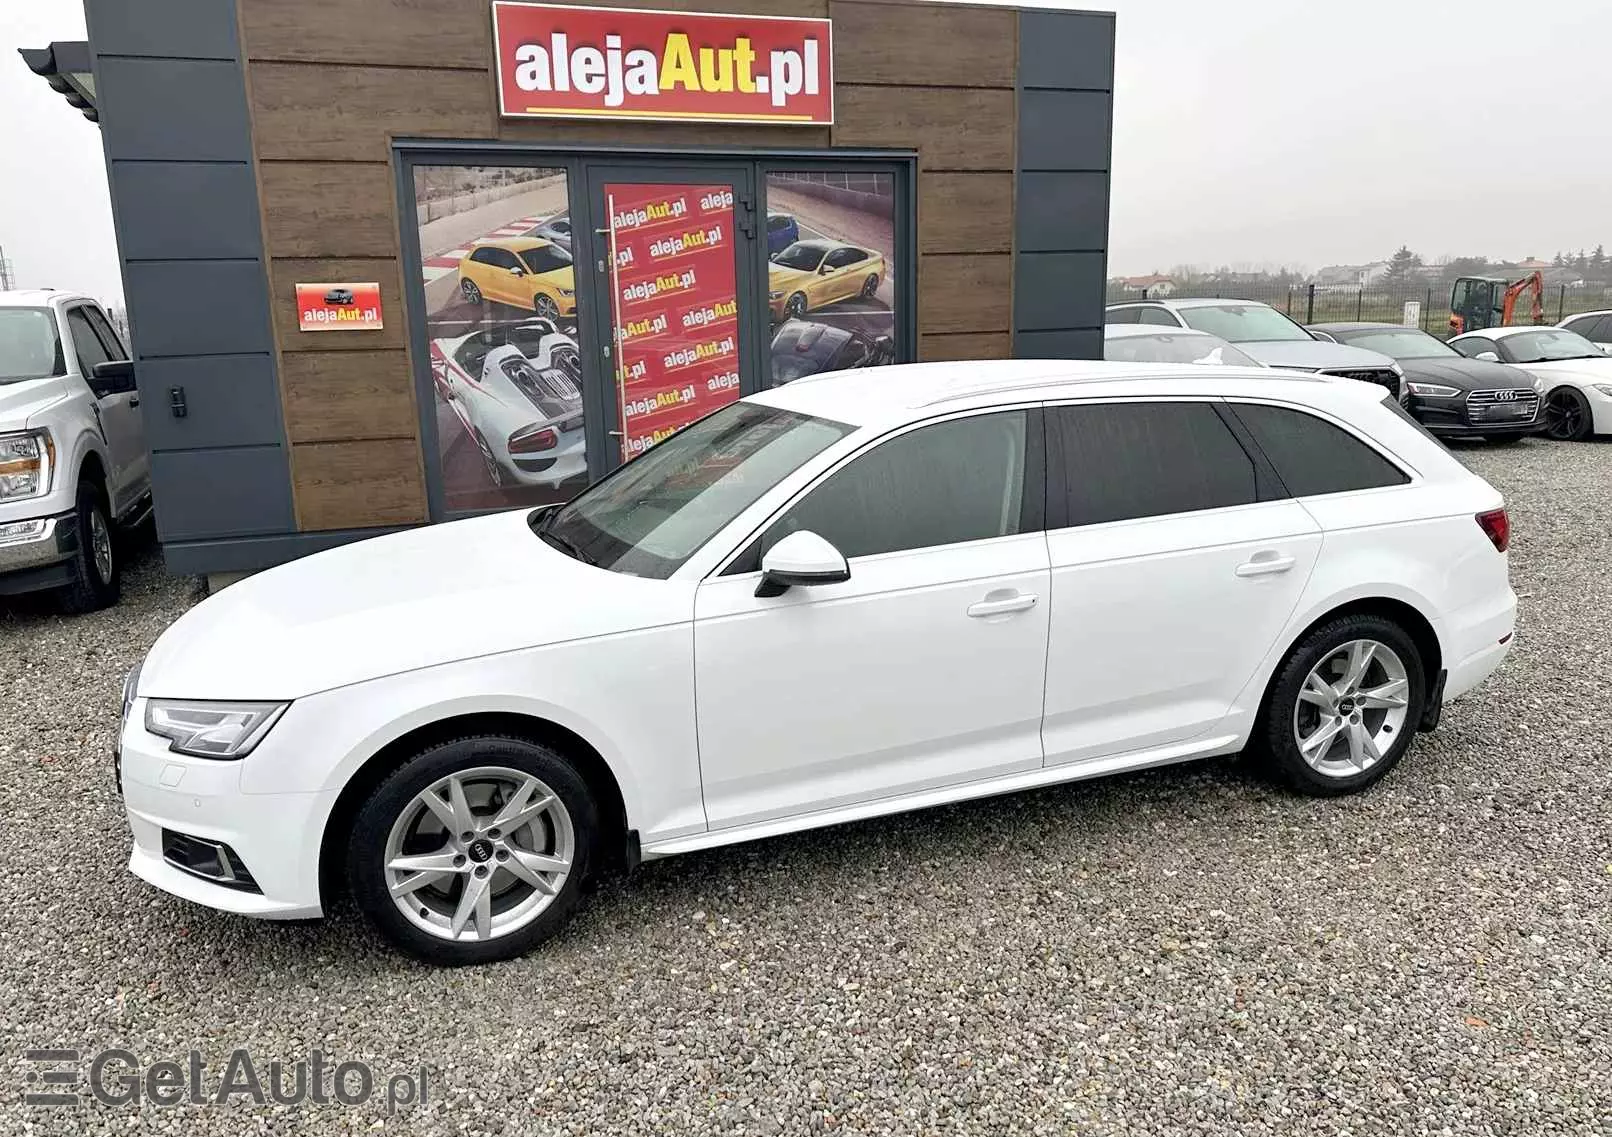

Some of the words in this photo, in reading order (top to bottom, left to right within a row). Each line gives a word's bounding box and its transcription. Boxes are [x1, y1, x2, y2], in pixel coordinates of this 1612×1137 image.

[515, 32, 818, 107] alejaAut.pl
[614, 197, 687, 228] alejaAut.pl
[649, 226, 722, 257] alejaAut.pl
[623, 269, 697, 301] alejaAut.pl
[304, 307, 377, 323] alejaAut.pl
[663, 337, 734, 368] alejaAut.pl
[625, 385, 696, 416] alejaAut.pl
